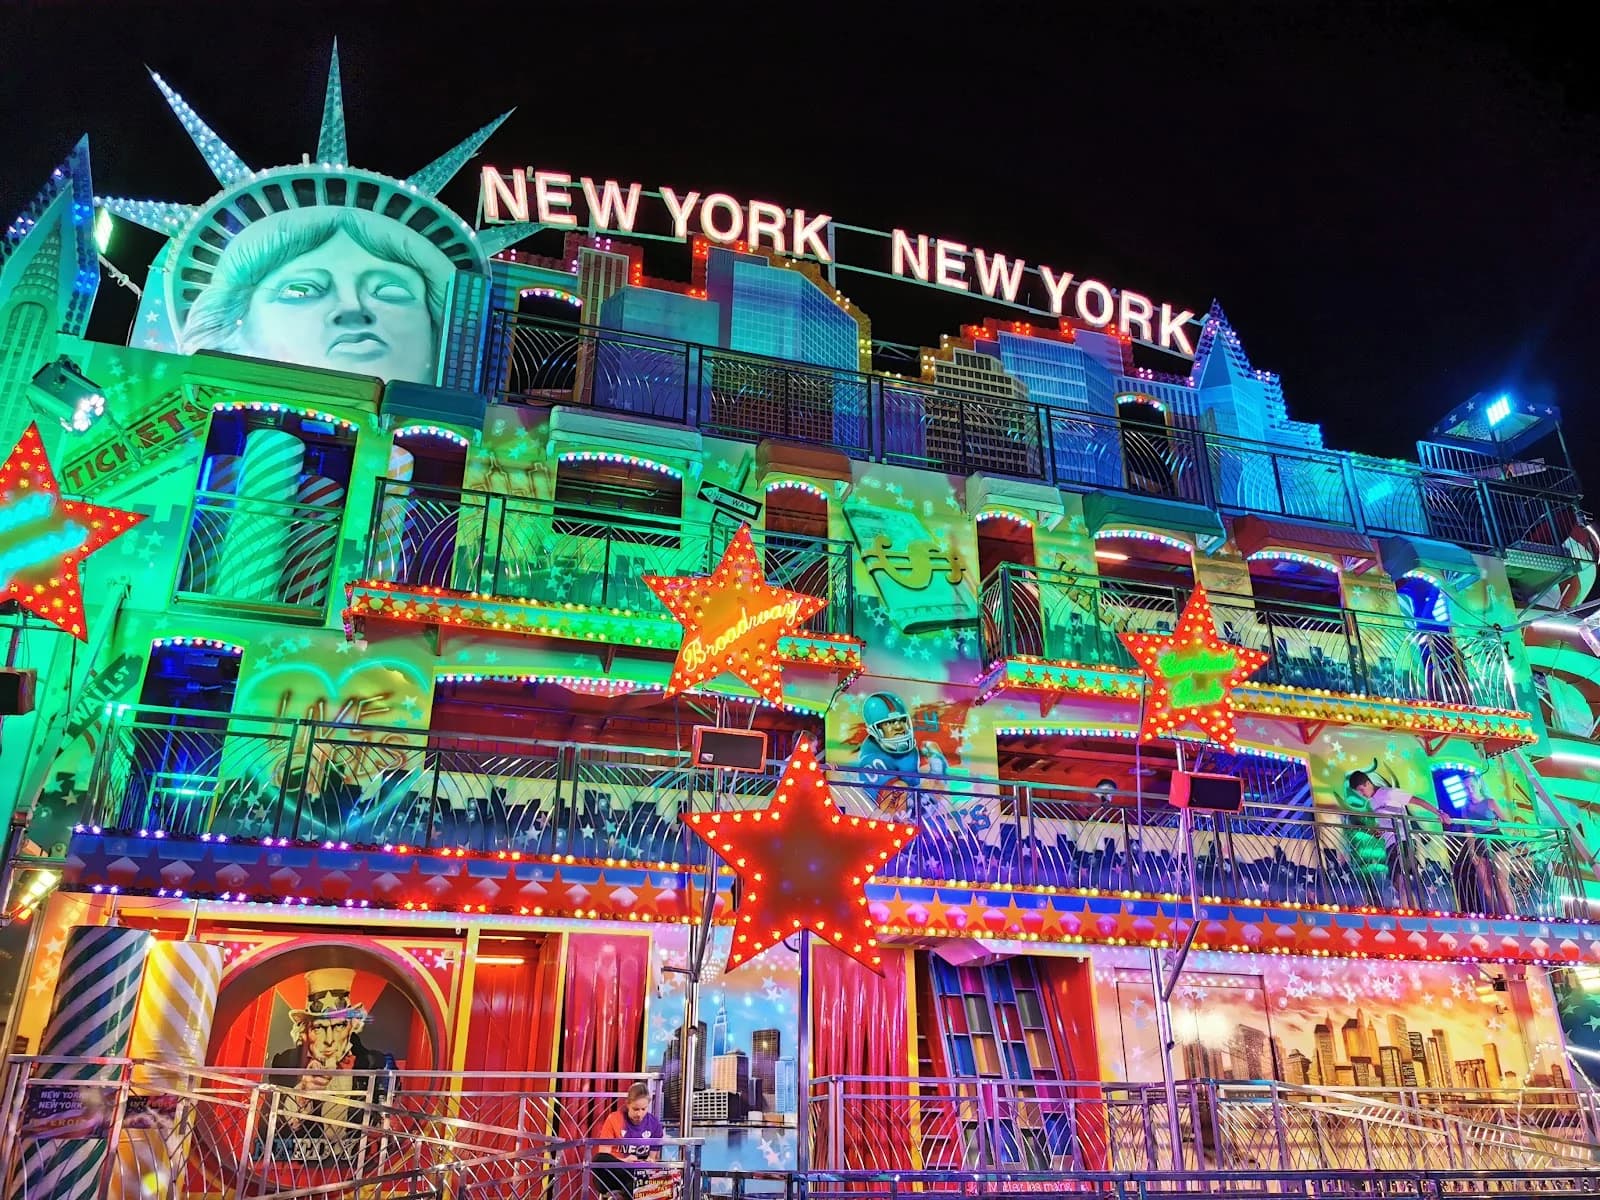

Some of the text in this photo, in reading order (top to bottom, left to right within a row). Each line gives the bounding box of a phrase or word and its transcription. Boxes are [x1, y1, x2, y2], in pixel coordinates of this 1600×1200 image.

[481, 165, 832, 263] NEW YORK
[891, 228, 1196, 356] NEW YORK
[732, 498, 752, 511] WAY
[682, 598, 804, 672] Broadway
[70, 679, 125, 726] WALL
